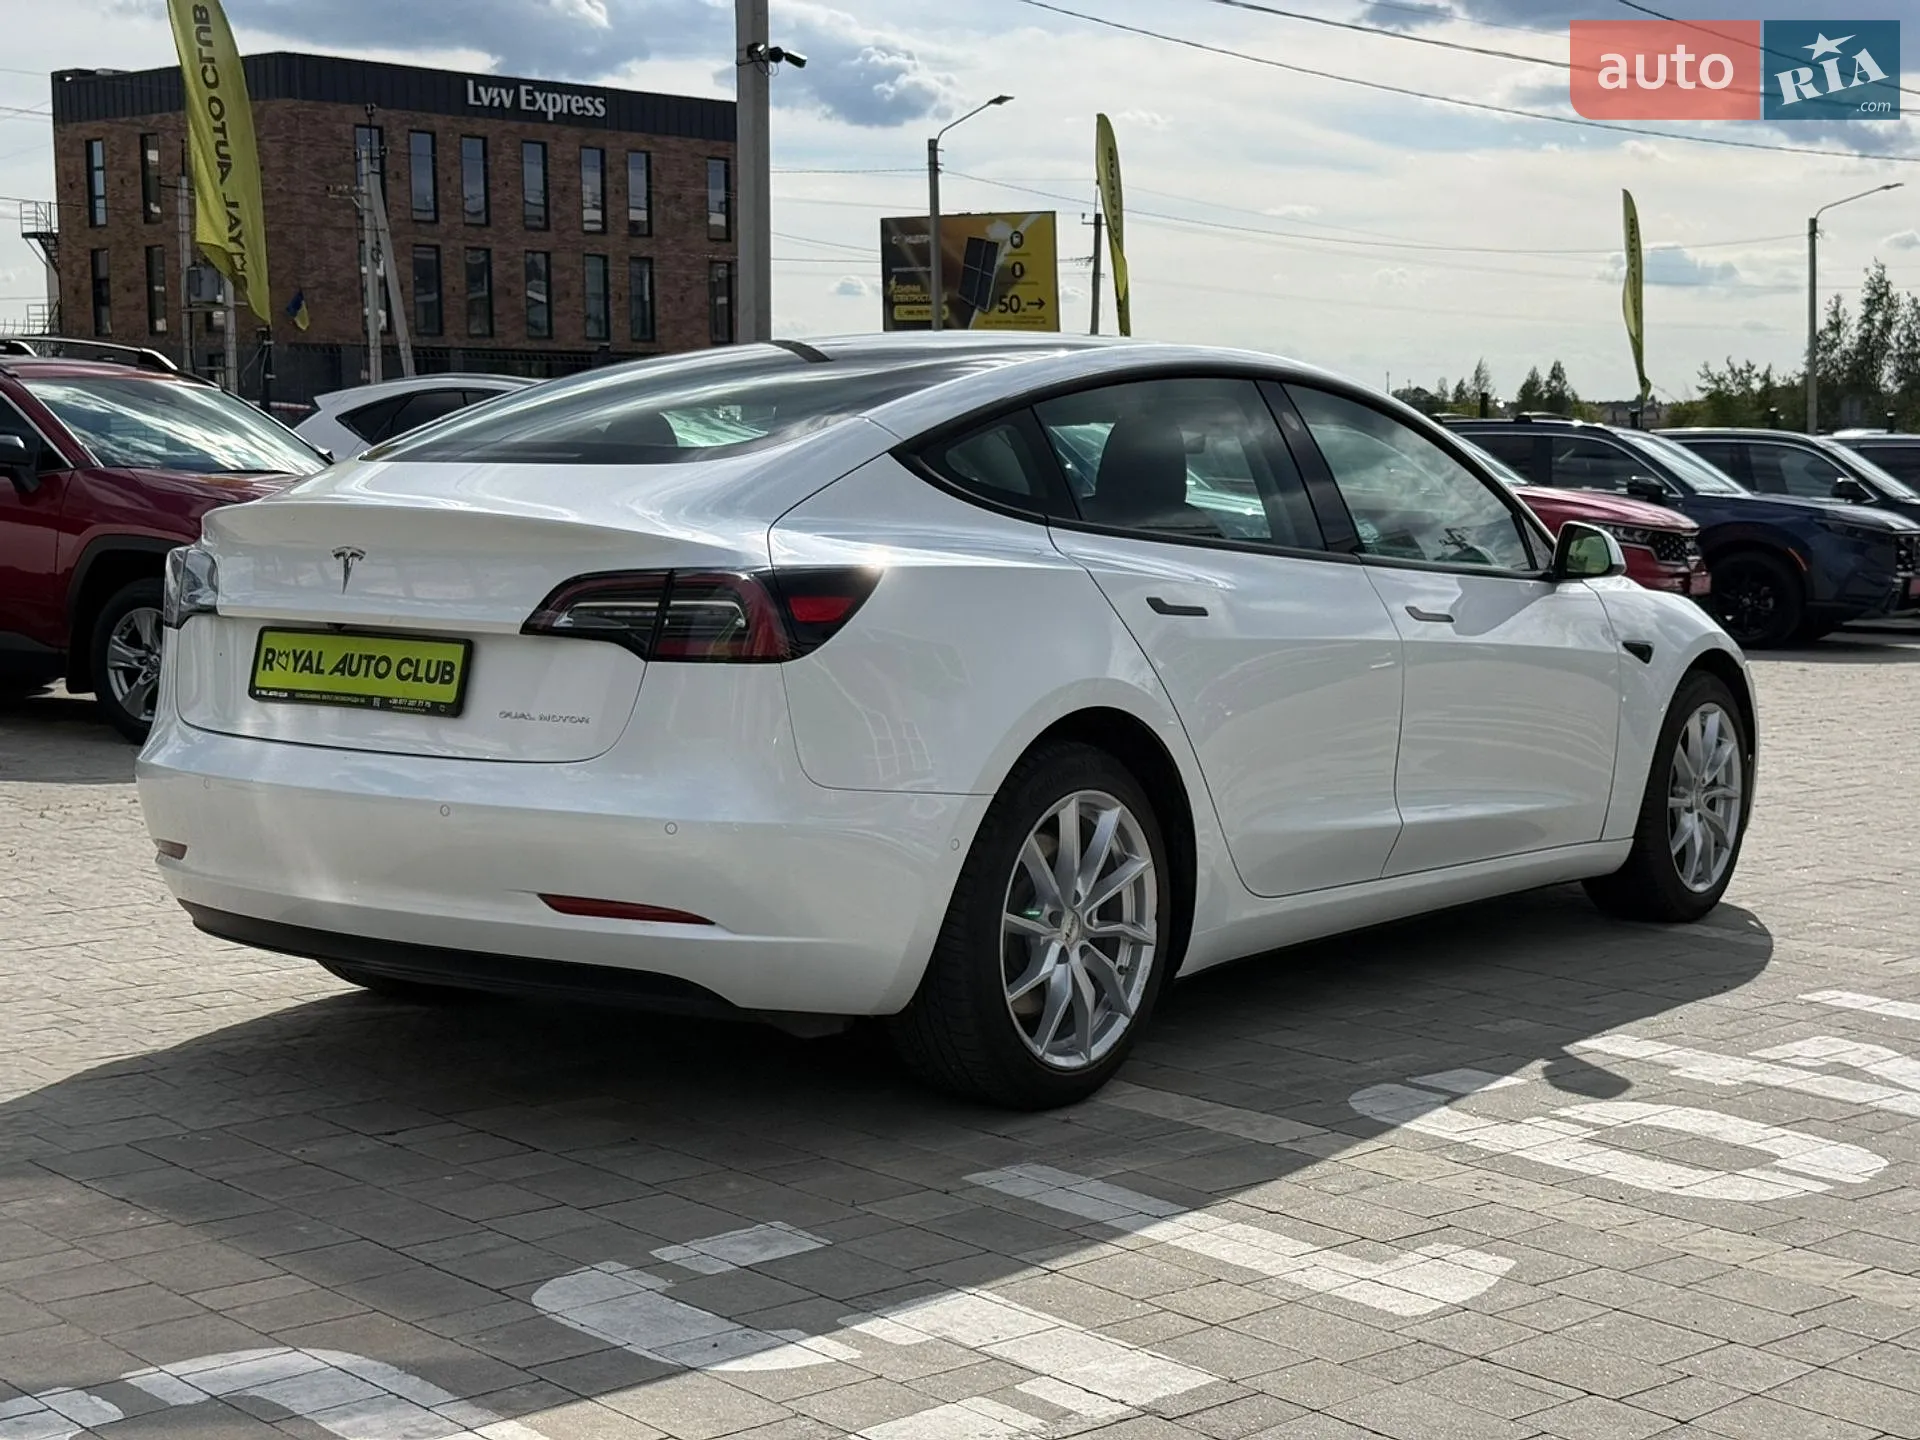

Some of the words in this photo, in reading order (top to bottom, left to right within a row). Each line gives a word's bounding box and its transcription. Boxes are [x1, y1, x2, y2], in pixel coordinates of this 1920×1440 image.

[466, 79, 515, 109] Lviv
[519, 84, 606, 121] Express
[328, 652, 392, 680] AUTO
[395, 657, 456, 685] CLUB
